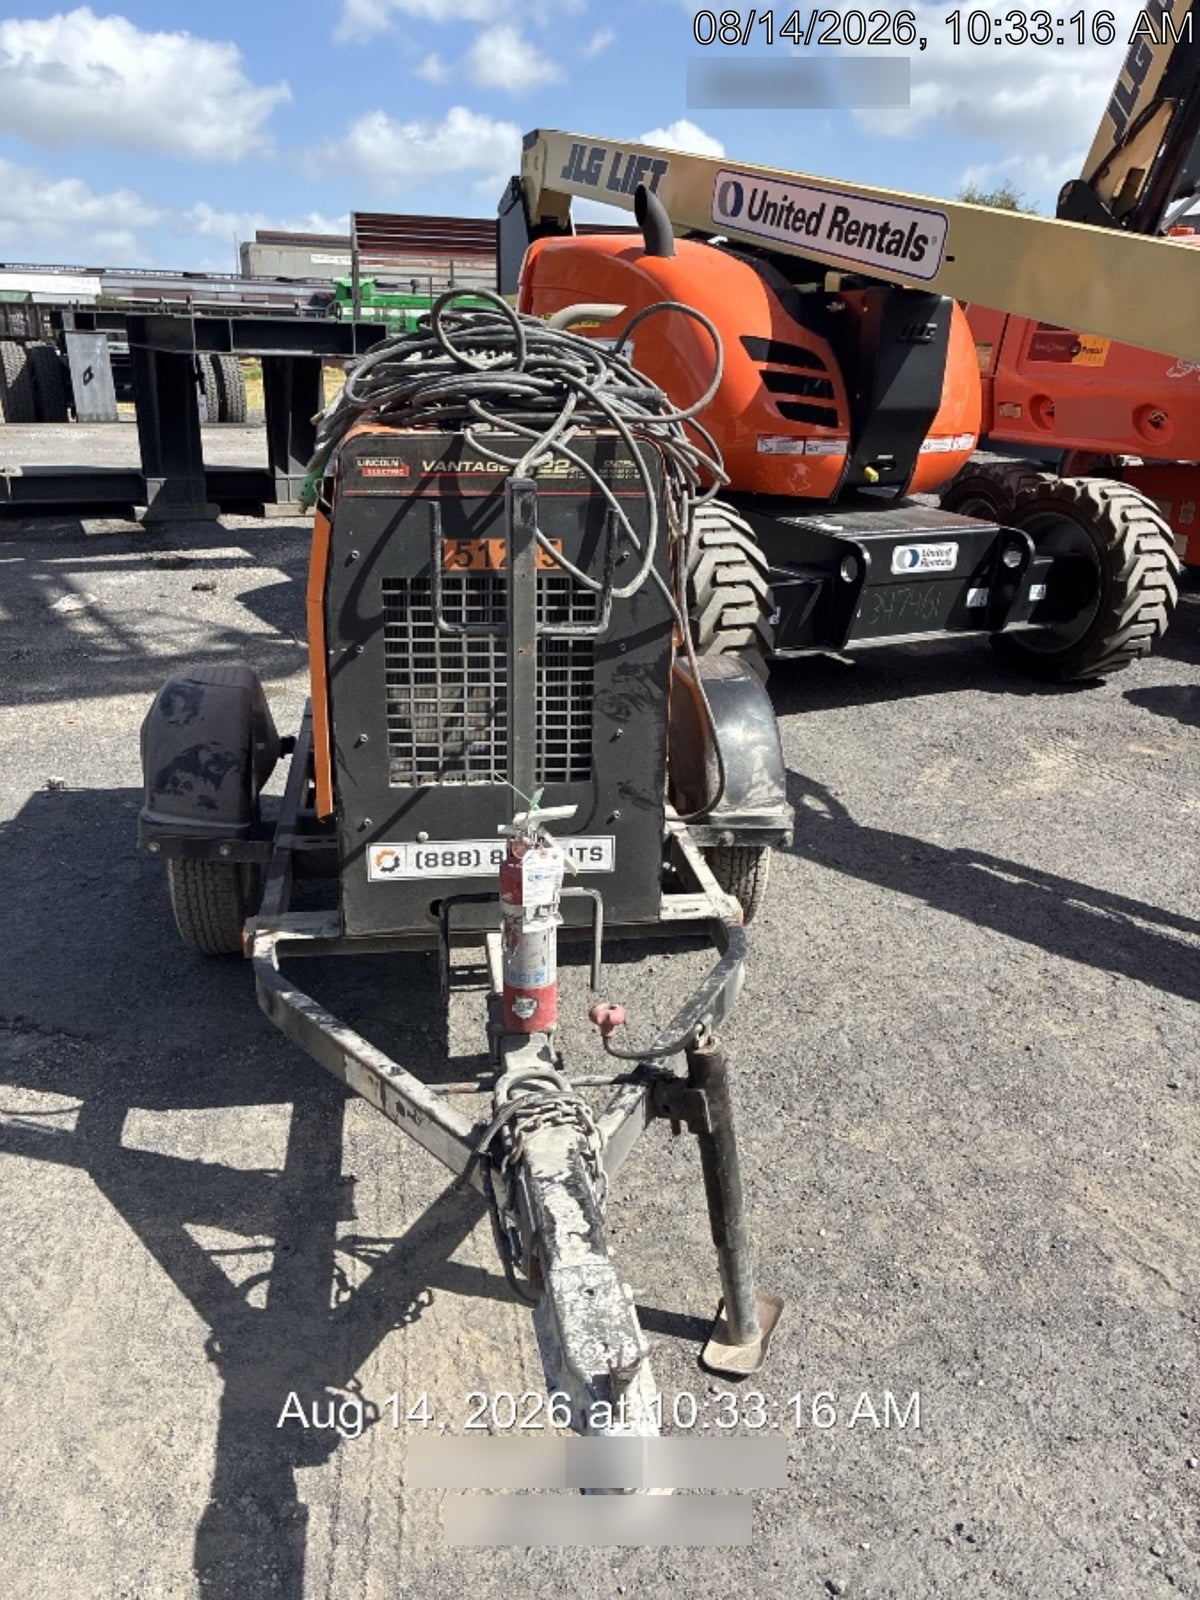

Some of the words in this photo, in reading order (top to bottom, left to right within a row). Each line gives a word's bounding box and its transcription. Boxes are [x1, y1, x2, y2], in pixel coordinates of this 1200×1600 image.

[560, 143, 607, 186] JLG
[606, 151, 671, 196] LIFT
[748, 187, 826, 237] United
[827, 205, 929, 262] Rentals
[357, 459, 399, 467] LINCOLN
[422, 460, 511, 472] VANTAGE
[415, 849, 481, 869] (888)
